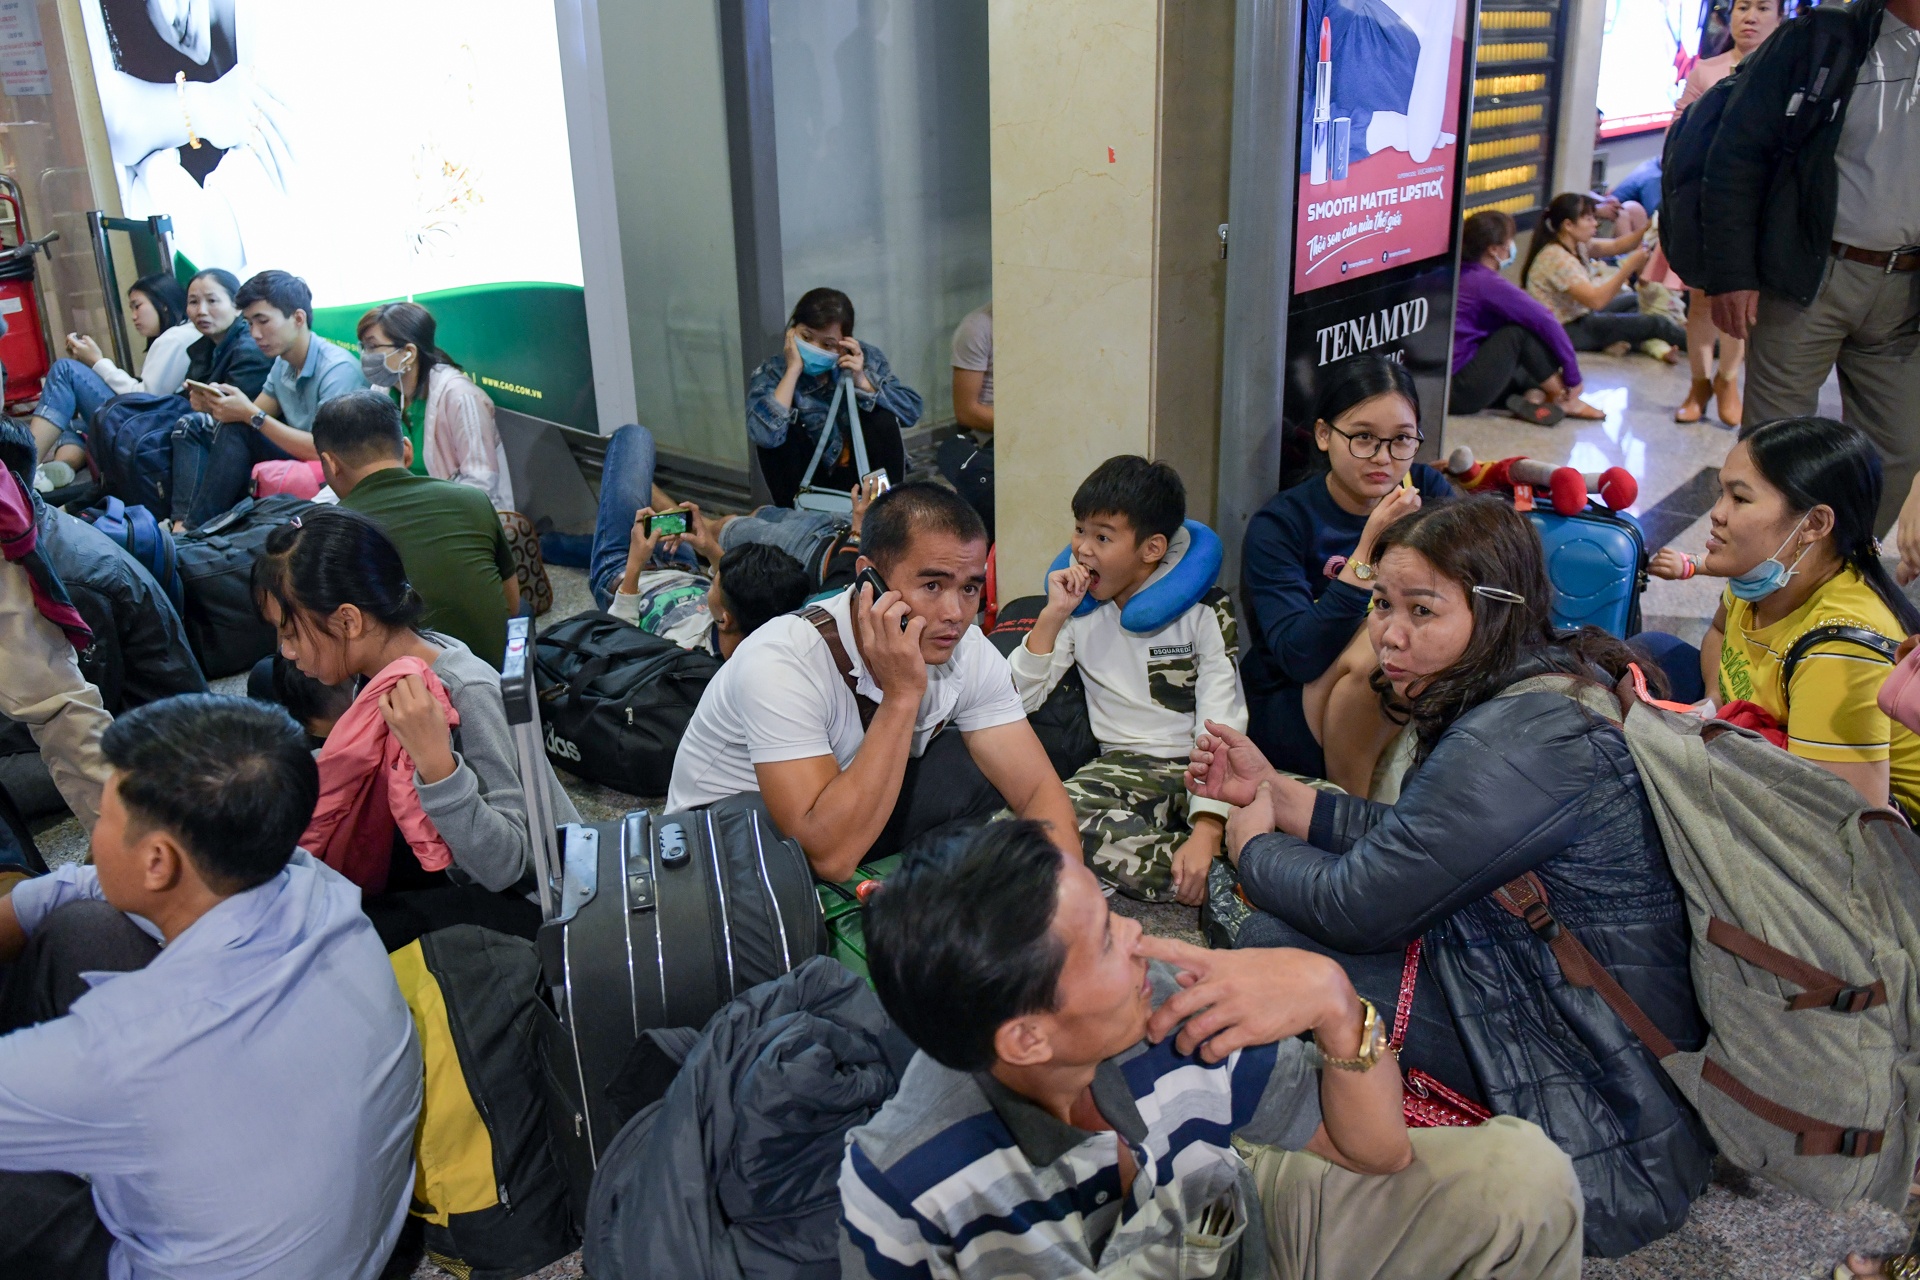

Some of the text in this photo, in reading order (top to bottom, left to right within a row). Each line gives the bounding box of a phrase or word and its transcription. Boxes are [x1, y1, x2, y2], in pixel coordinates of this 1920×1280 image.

[1308, 196, 1357, 221] SMOOTH
[1360, 187, 1398, 210] MATTE
[1400, 176, 1444, 201] LIPSTICK
[1316, 297, 1429, 367] TENAMYD
[481, 376, 543, 399] WWW.CAO.COM.VN
